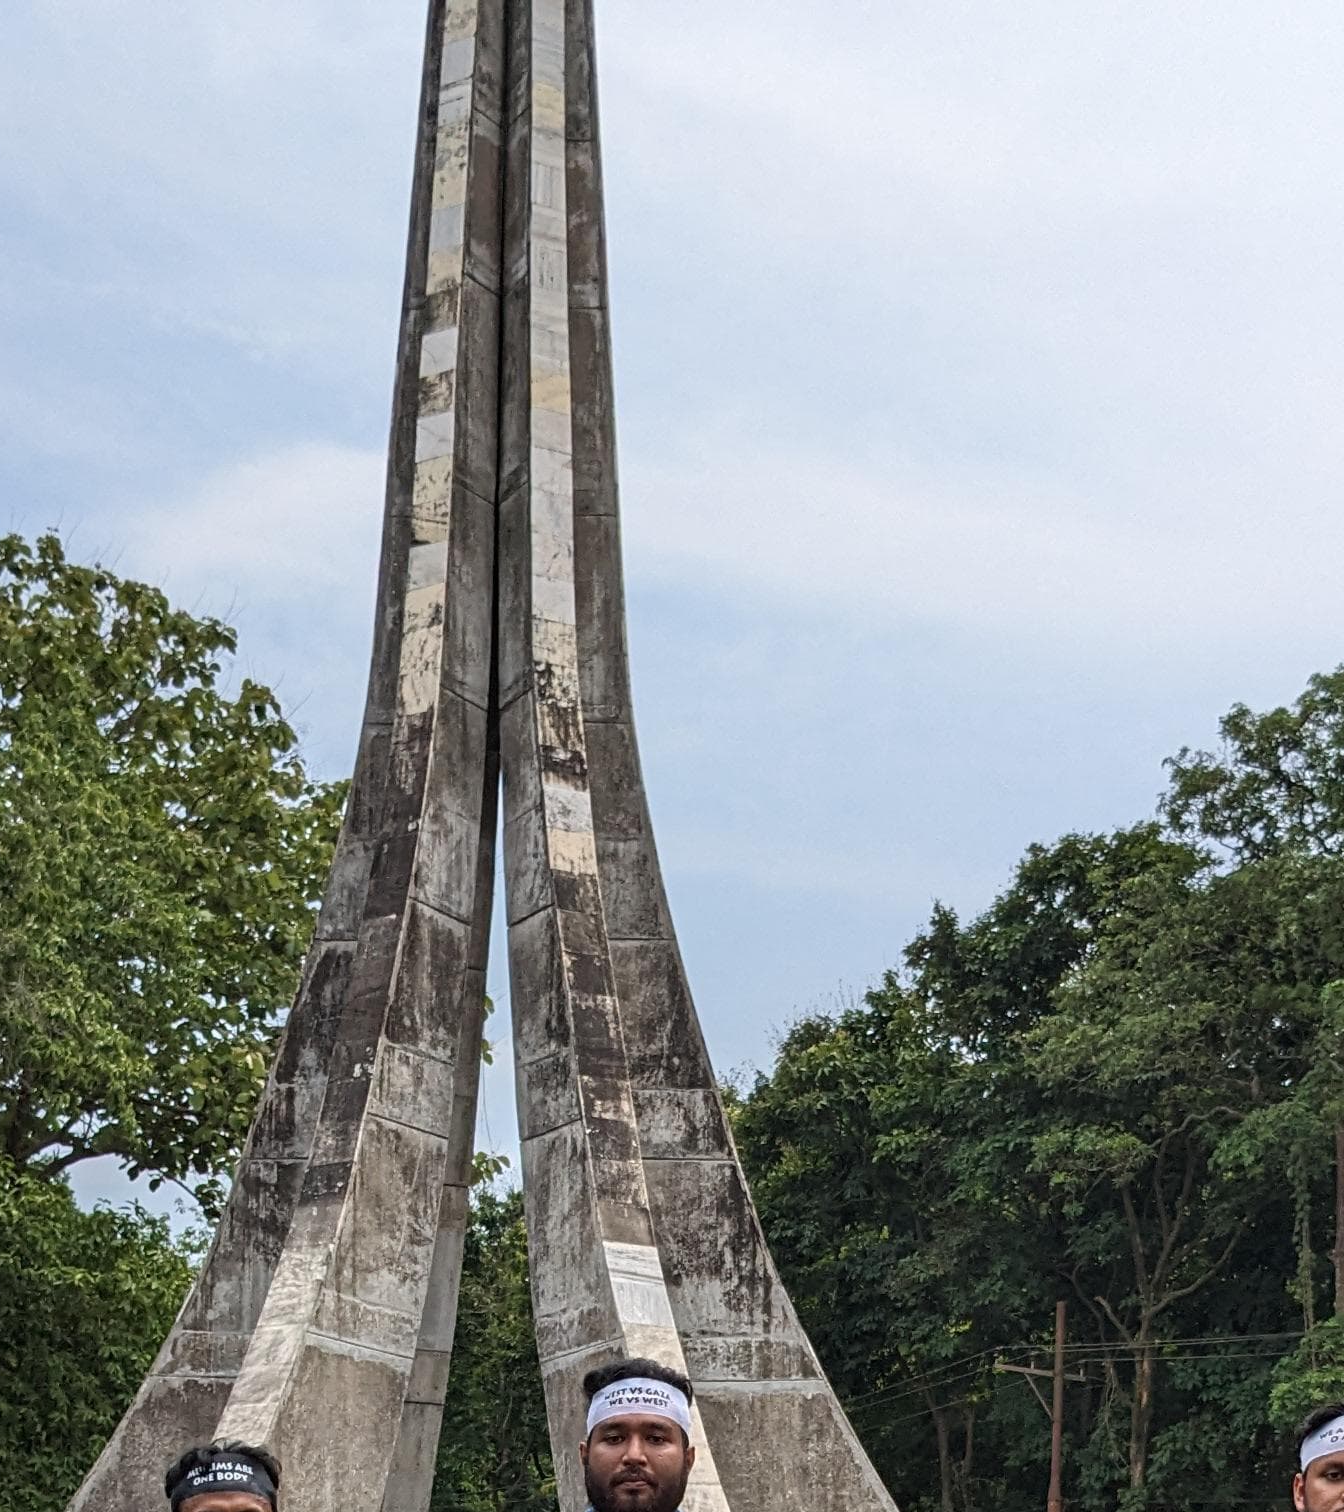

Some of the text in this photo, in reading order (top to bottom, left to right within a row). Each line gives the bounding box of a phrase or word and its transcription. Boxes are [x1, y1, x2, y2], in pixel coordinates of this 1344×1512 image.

[630, 1387, 643, 1395] VS
[609, 1397, 623, 1407] WE
[642, 1396, 669, 1407] WEST
[1319, 1430, 1336, 1440] WE
[235, 1463, 254, 1476] ARE
[193, 1471, 249, 1486] ONE BODY
